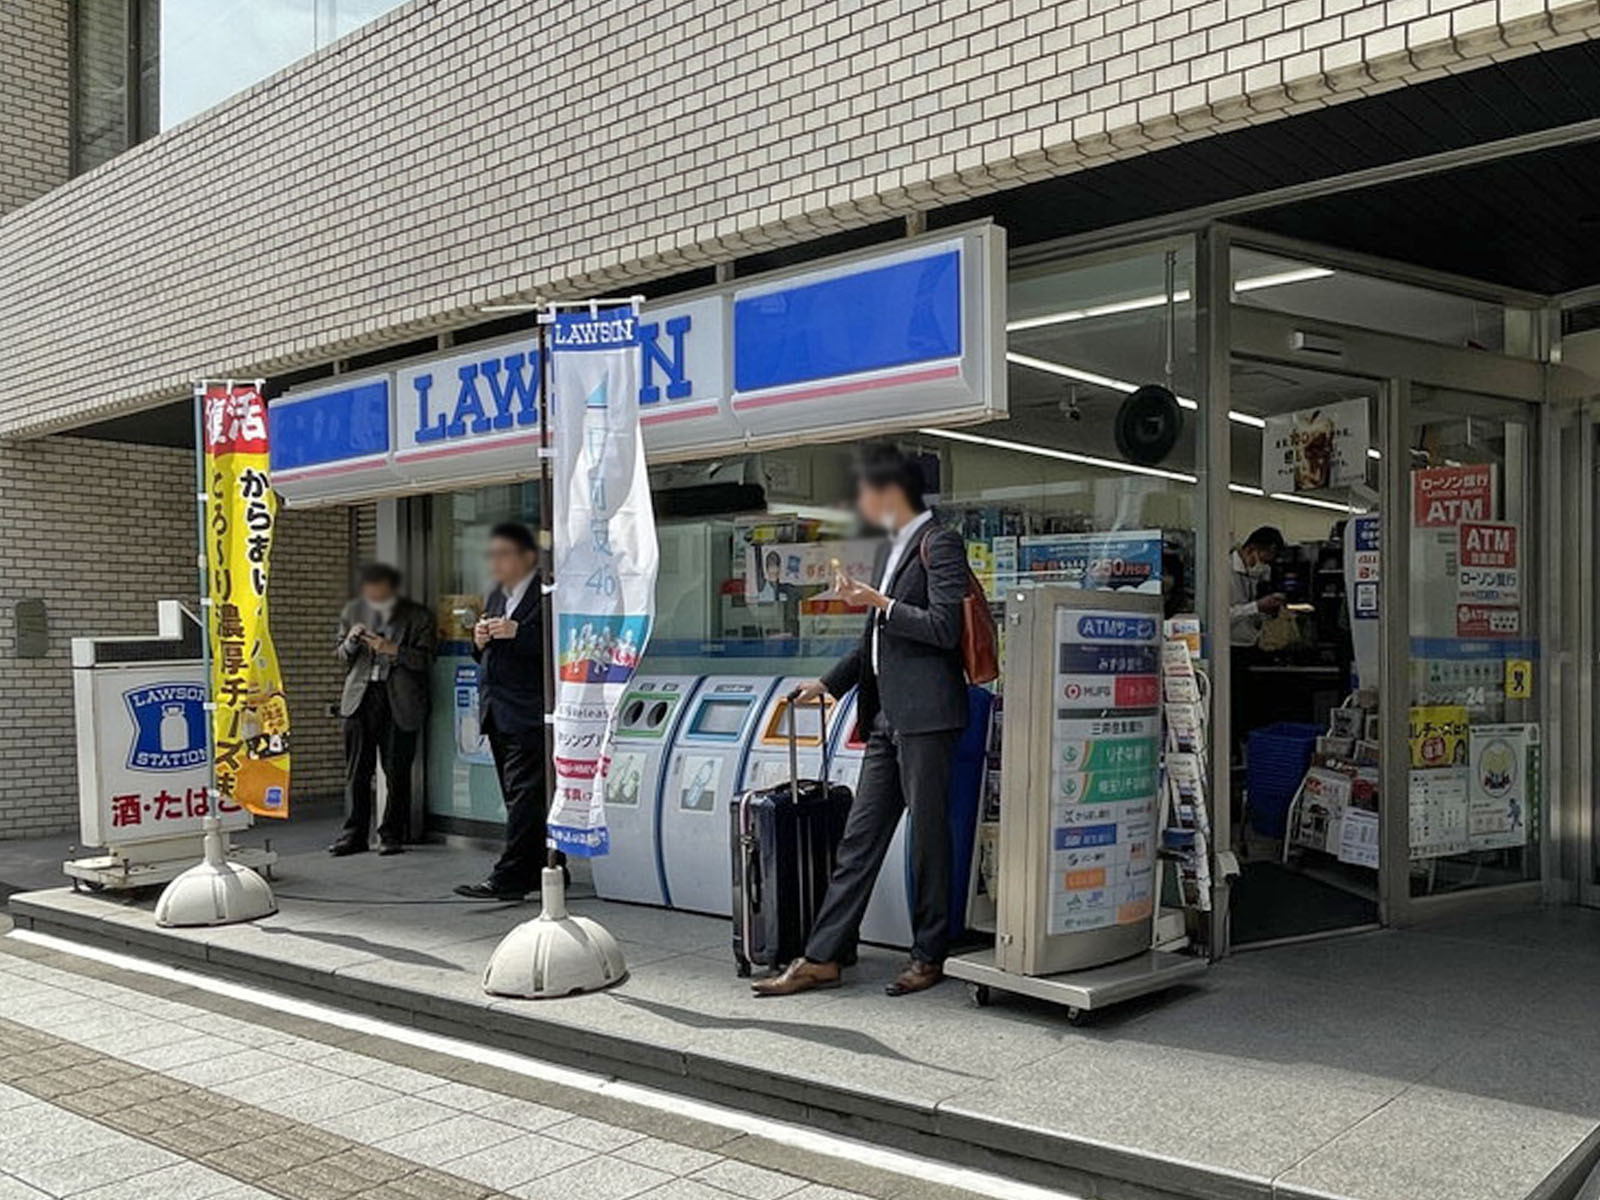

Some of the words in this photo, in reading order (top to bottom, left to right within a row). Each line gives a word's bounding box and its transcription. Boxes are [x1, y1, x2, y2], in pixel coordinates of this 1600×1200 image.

[413, 314, 693, 444] LAWN
[1421, 473, 1489, 490] ローソン銀行
[1427, 497, 1484, 523] ATM
[1466, 528, 1512, 553] ATM
[1460, 572, 1518, 587] ローソン銀行
